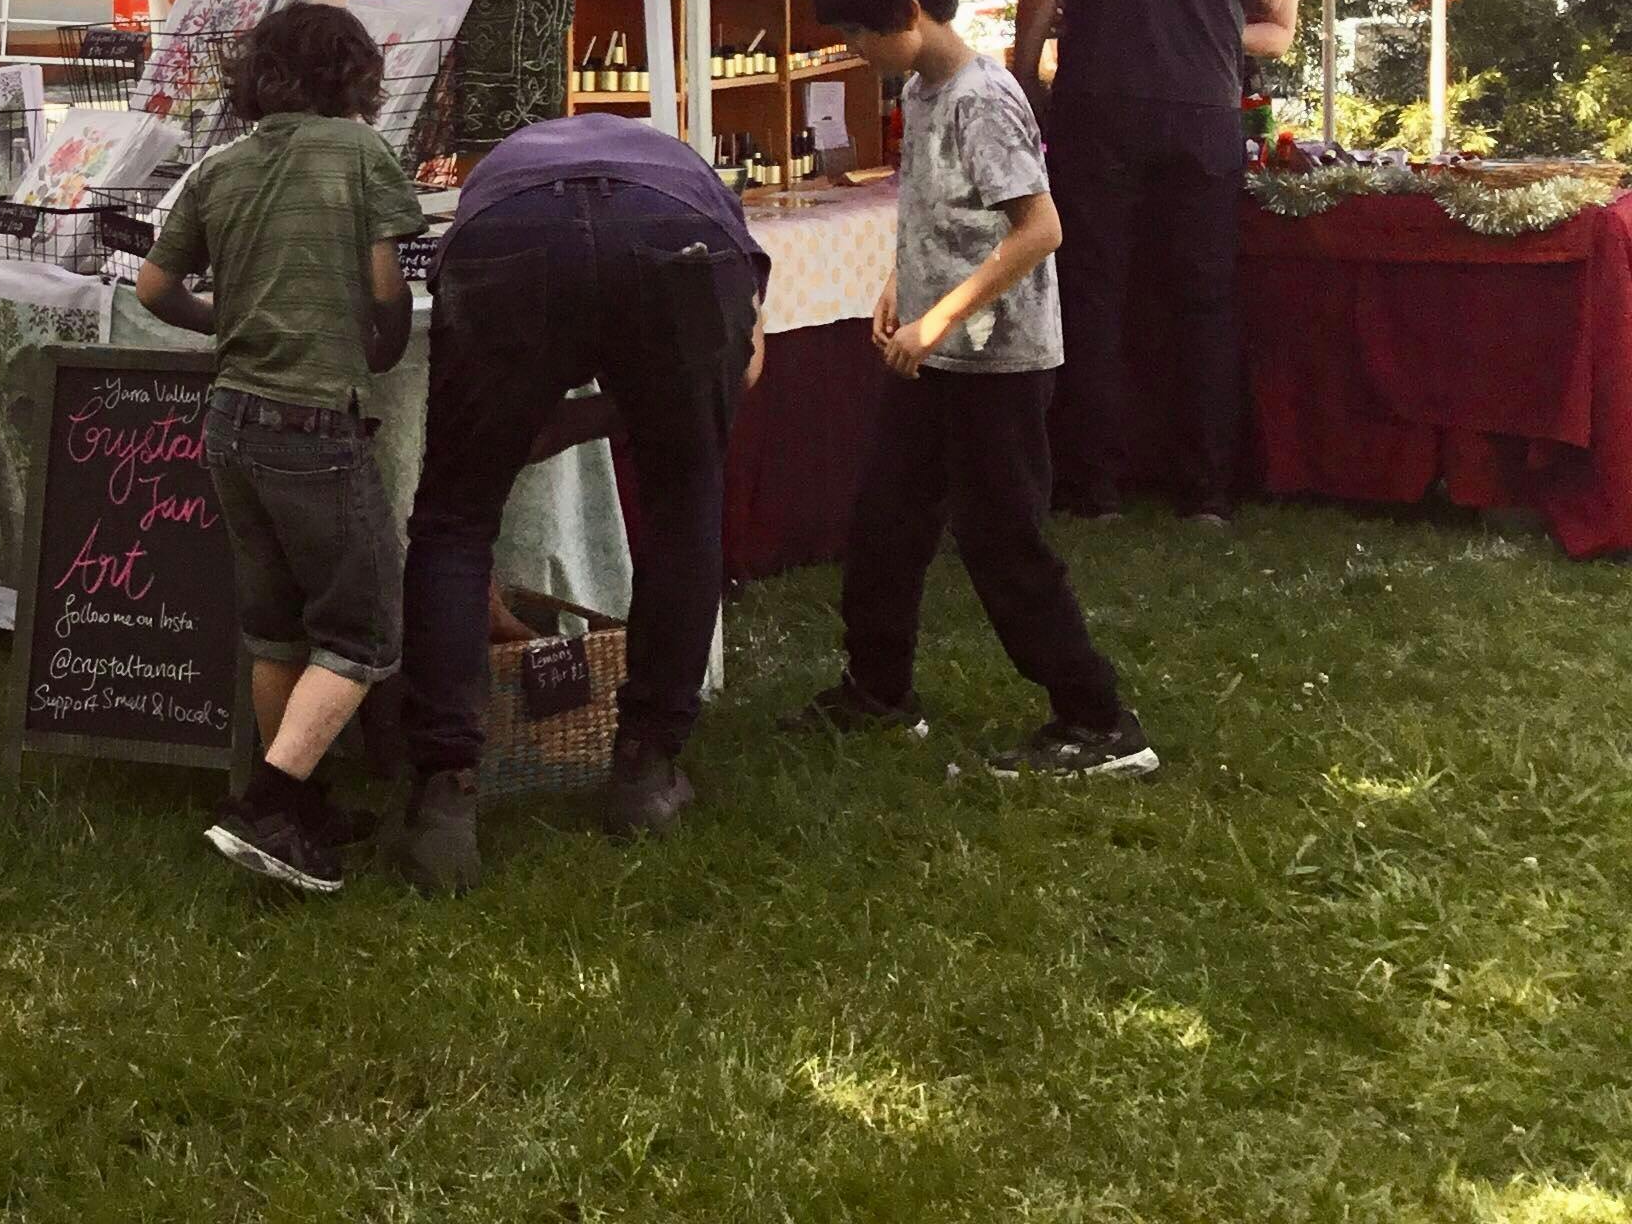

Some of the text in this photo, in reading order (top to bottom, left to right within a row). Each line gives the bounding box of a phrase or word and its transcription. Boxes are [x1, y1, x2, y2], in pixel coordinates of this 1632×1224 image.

[105, 377, 151, 409] Yarra
[154, 379, 201, 424] Valley
[53, 517, 155, 600] Art
[50, 648, 201, 691] @crystaltanart
[531, 650, 573, 669] Lemons
[152, 692, 164, 722] &
